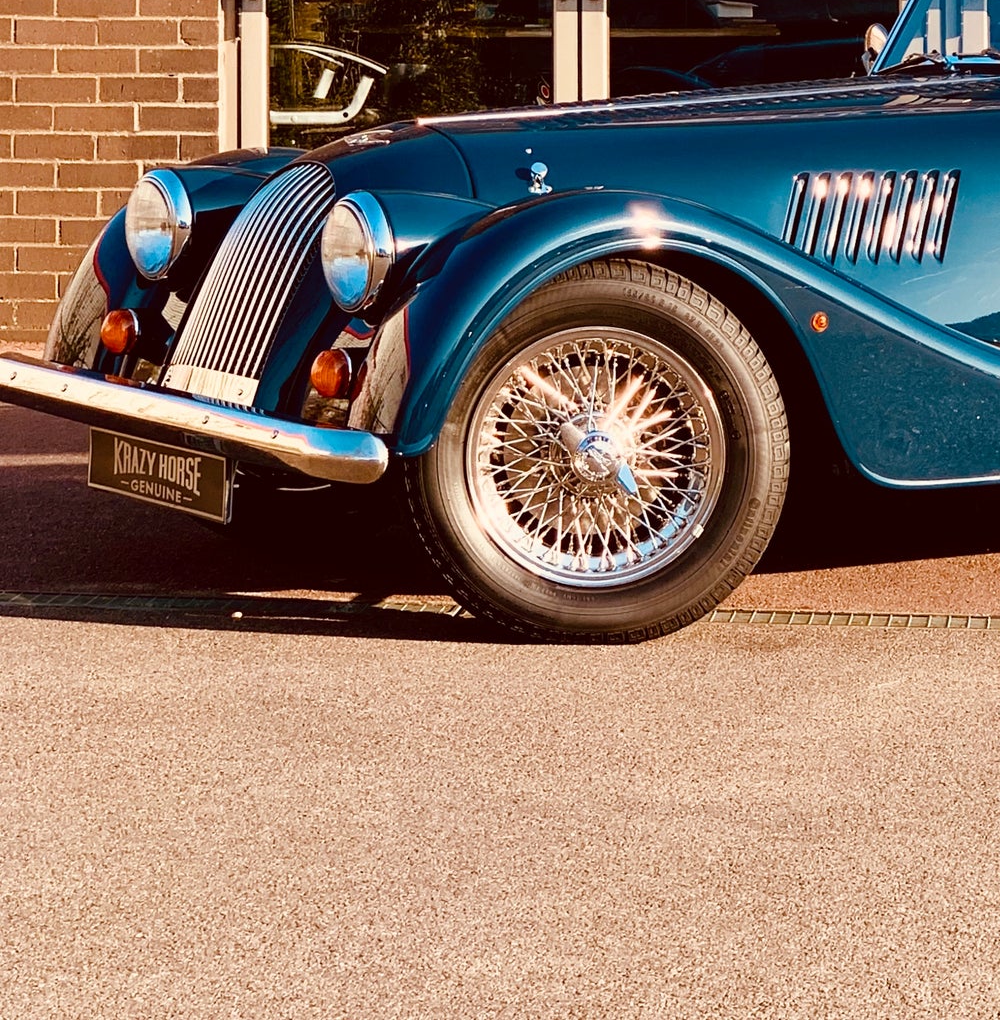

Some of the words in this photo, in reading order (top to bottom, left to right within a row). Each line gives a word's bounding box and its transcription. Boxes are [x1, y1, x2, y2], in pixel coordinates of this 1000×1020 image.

[113, 437, 156, 476] KRAZY
[158, 453, 202, 497] HORSE
[130, 479, 182, 503] GENUINE
